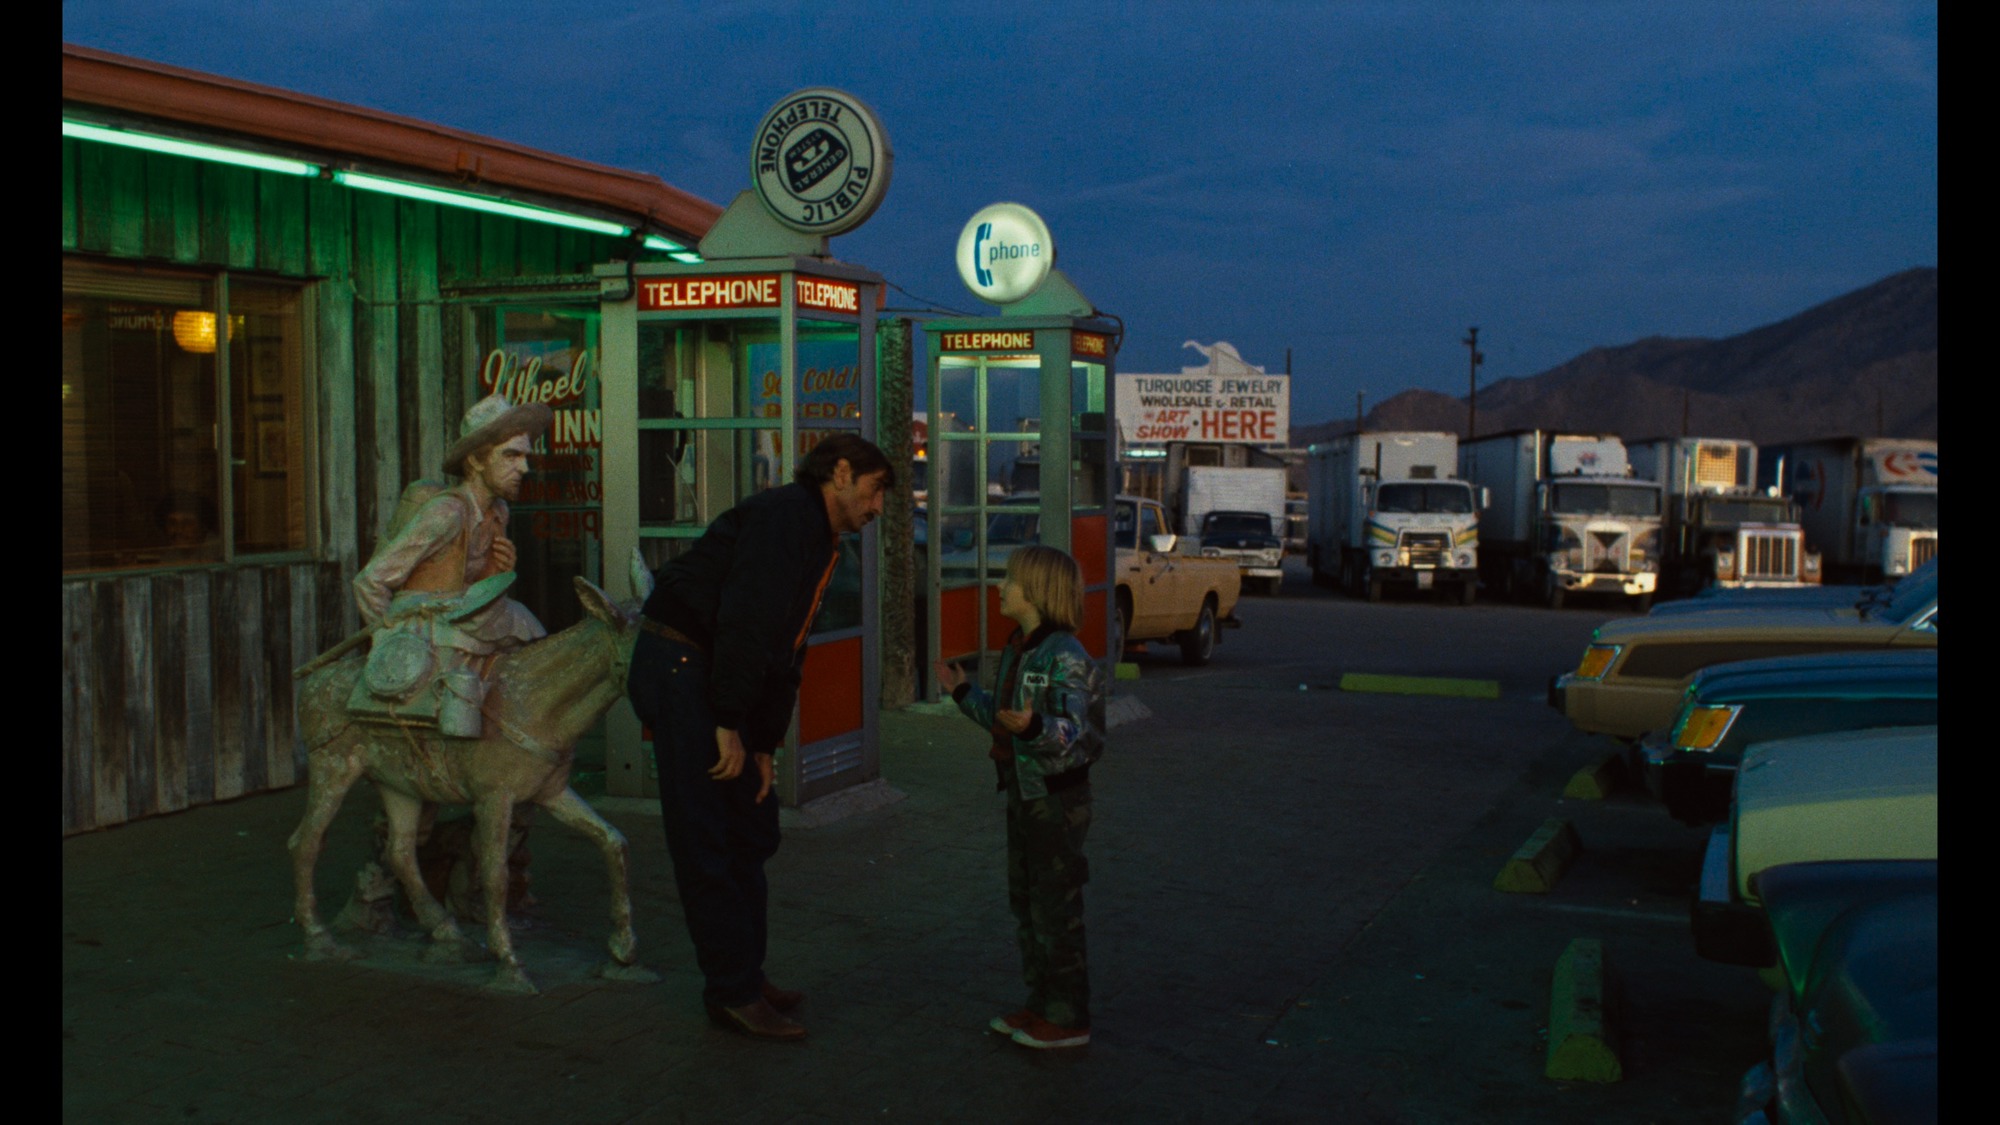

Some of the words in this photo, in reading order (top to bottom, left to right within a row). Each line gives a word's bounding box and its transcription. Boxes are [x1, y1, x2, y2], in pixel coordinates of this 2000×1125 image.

[760, 101, 842, 175] TELEPHONE
[794, 148, 845, 191] GENERAL
[802, 166, 869, 222] PUBLIC
[989, 241, 1041, 266] phone
[644, 278, 777, 307] TELEPHONE
[797, 280, 858, 311] TELEPHONE
[944, 332, 1033, 350] TELEPHONE
[482, 348, 588, 405] Wheel
[1135, 378, 1213, 394] TURQUOISE
[1218, 379, 1283, 394] JEWELRY
[1140, 395, 1213, 409] WHOLESALE
[1229, 396, 1277, 409] RETAIL
[1155, 409, 1191, 424] ART
[553, 408, 602, 446] INN
[1135, 425, 1191, 440] SHOW
[1200, 409, 1277, 440] HERE
